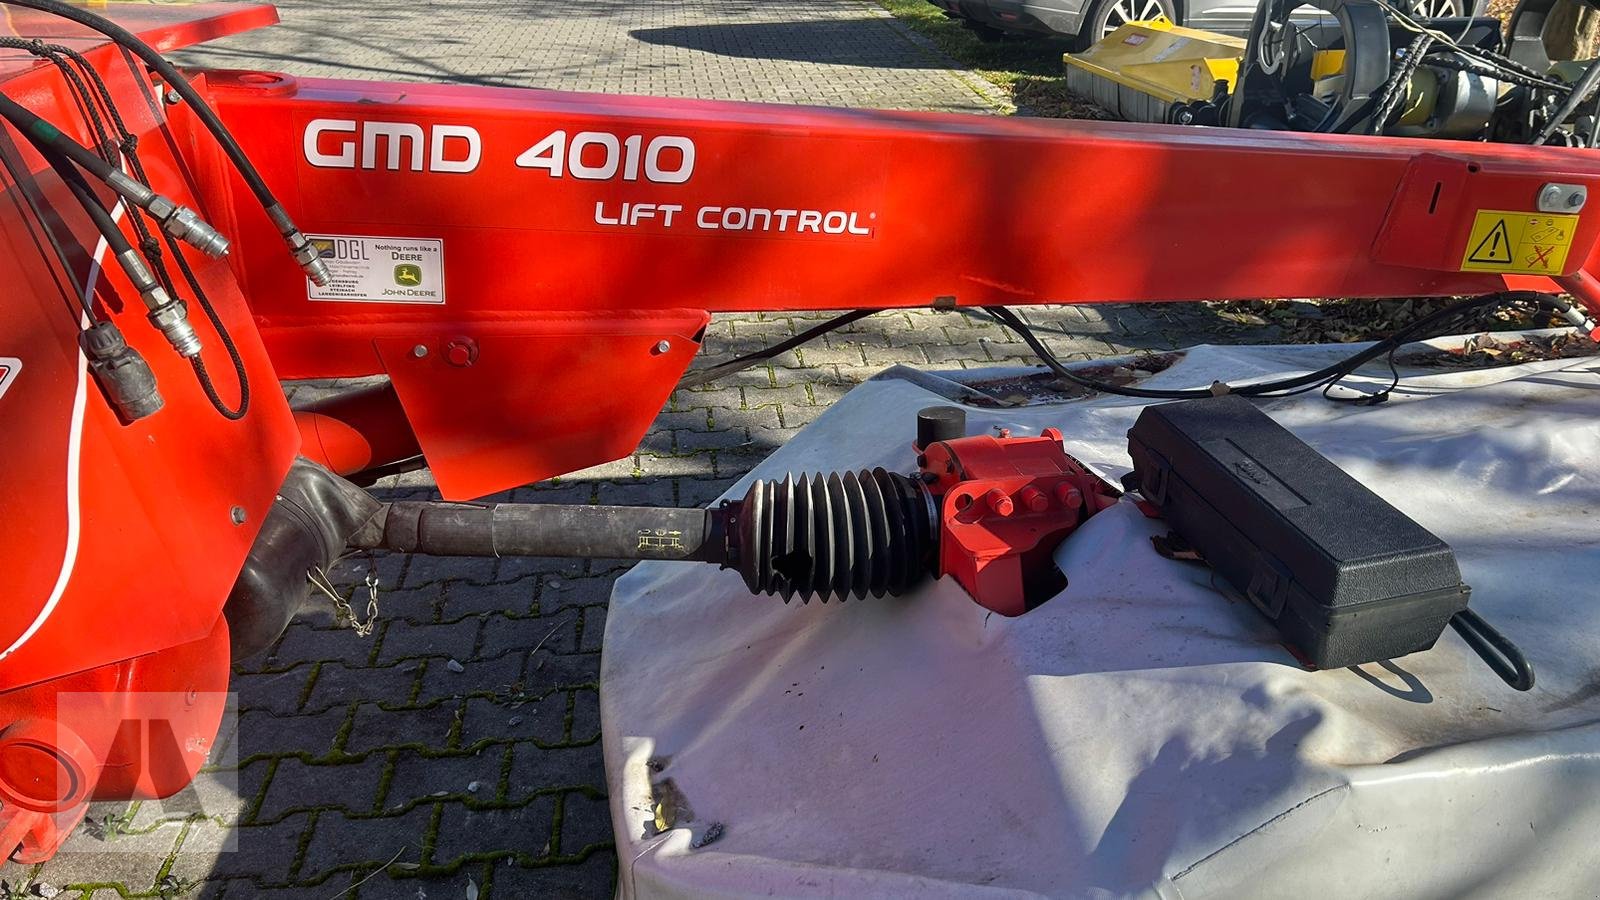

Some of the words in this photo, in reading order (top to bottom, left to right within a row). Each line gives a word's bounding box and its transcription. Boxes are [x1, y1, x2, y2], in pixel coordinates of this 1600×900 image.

[302, 118, 482, 174] GMD
[515, 129, 696, 184] 4010
[594, 201, 683, 227] LIFT
[696, 206, 871, 235] CONTROL
[337, 239, 370, 260] DGL
[375, 244, 402, 252] Nothing
[391, 251, 423, 261] DEERE
[381, 288, 407, 296] JOHN
[407, 289, 437, 297] DEERE
